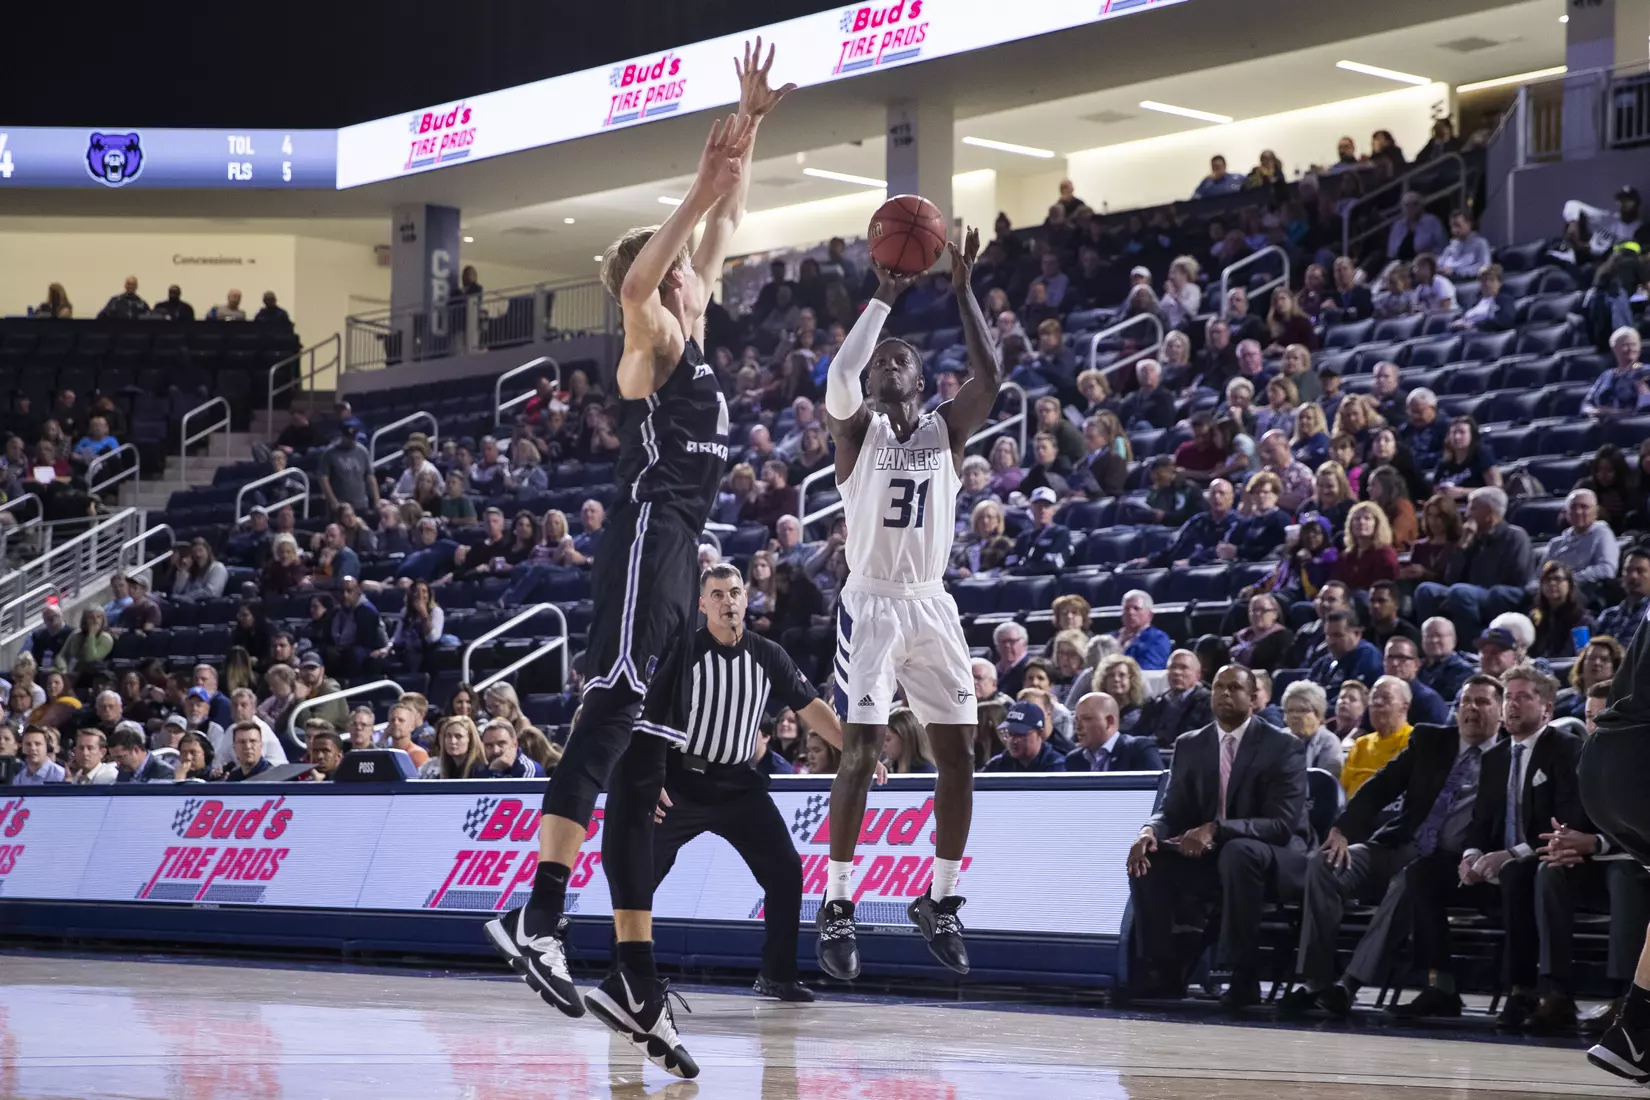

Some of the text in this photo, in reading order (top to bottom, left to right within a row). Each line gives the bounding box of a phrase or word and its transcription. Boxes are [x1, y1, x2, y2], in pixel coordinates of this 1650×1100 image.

[834, 22, 929, 75] TIRE PROS
[620, 52, 682, 88] Bud's
[419, 101, 472, 133] Bud's
[604, 79, 687, 126] TIRE PROS
[227, 134, 293, 155] TOL 4
[404, 128, 477, 170] TIRE PROS
[227, 161, 292, 182] FLS 5
[172, 252, 243, 266] Concessions
[875, 447, 941, 471] LANCERS
[883, 478, 930, 528] 31
[358, 761, 375, 774] POSS
[184, 796, 293, 840] Bud's
[140, 846, 290, 901] TIRE PROS
[429, 850, 520, 908] TIRE
